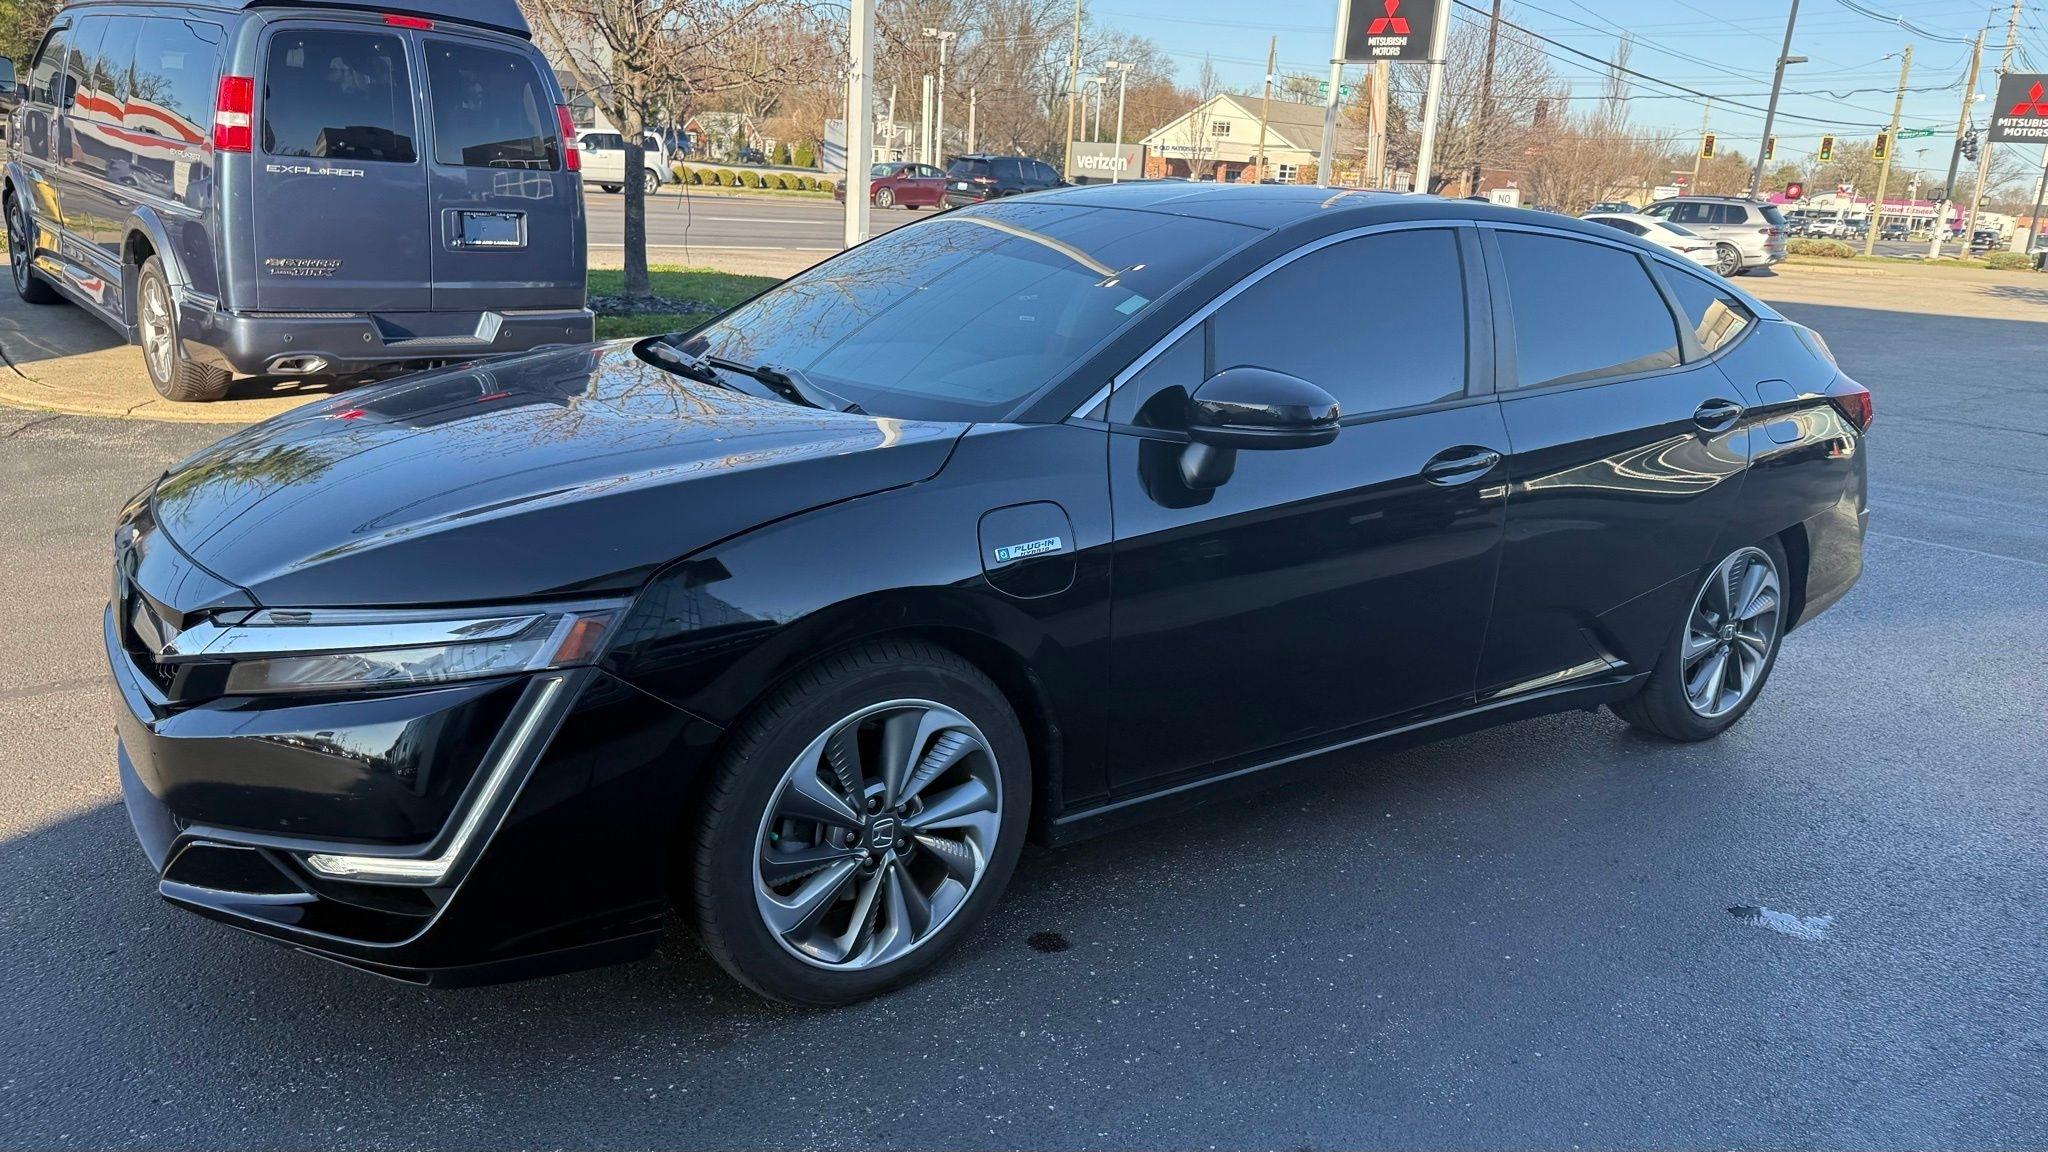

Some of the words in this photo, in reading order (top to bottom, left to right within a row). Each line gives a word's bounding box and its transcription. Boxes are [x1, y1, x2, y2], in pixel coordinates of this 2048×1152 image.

[1367, 37, 1408, 46] MITSUBISHI
[1372, 47, 1401, 56] MOTORS
[2003, 128, 2048, 137] MOTORS
[1077, 153, 1128, 171] verizon
[266, 164, 364, 177] EXPLORER
[1498, 194, 1511, 204] NO
[1014, 539, 1054, 553] PLUG-IN
